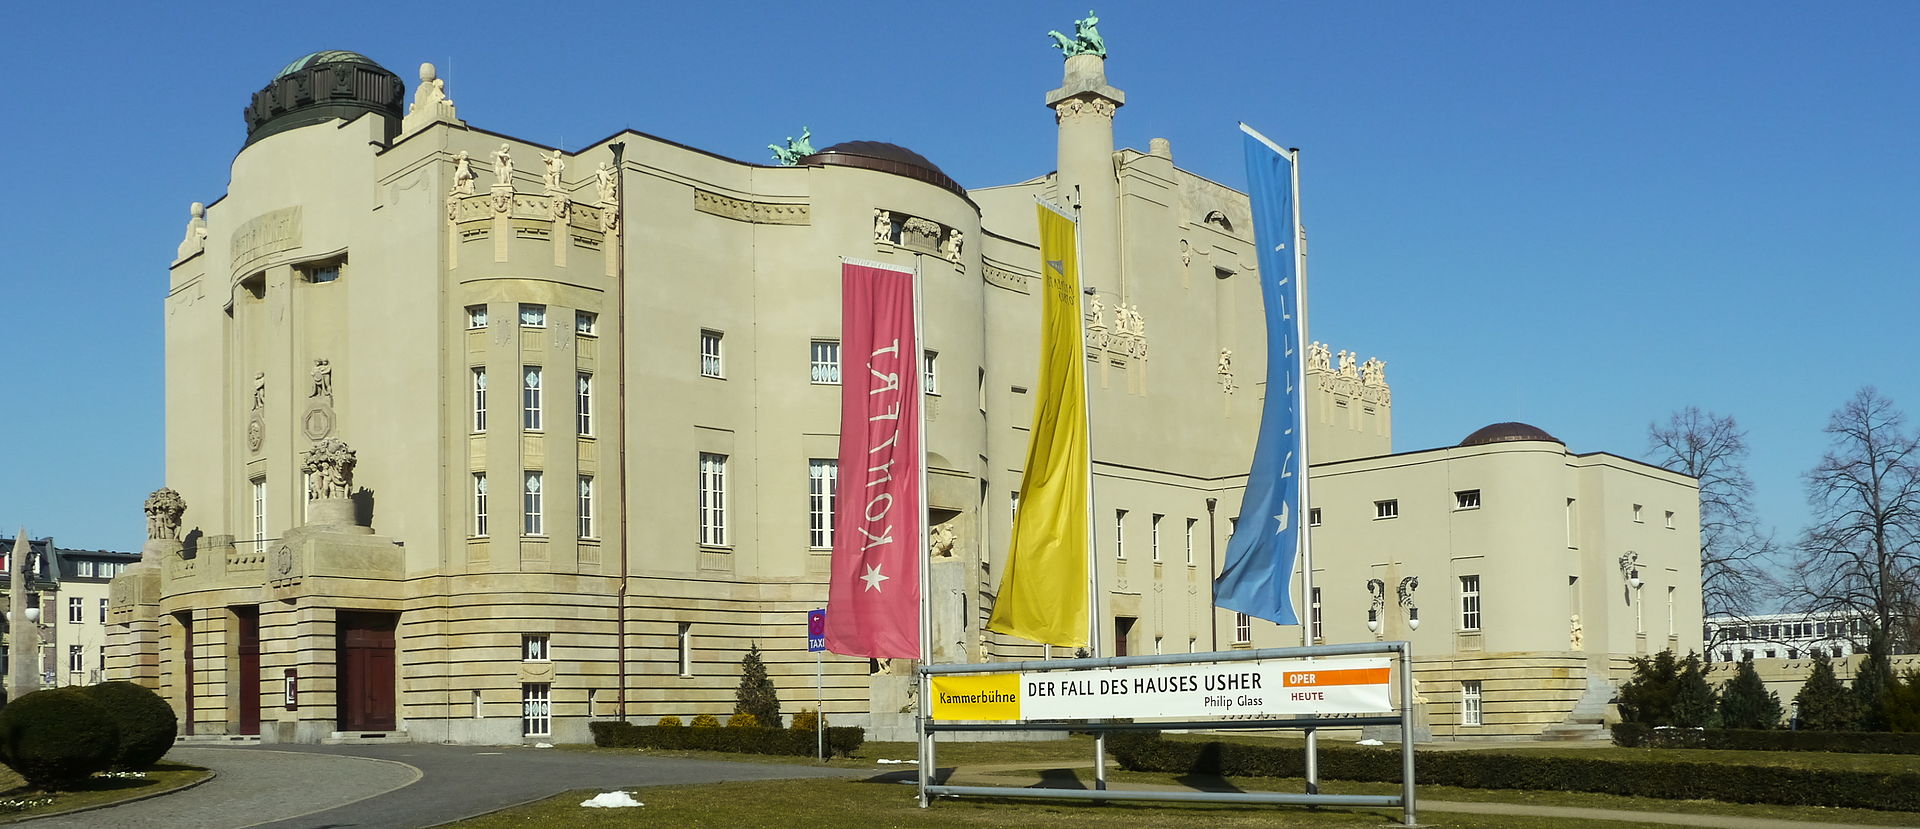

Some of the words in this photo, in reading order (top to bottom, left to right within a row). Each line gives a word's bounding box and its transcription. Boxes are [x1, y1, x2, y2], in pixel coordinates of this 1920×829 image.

[809, 638, 825, 649] TAXI
[1028, 681, 1055, 697] DER
[1061, 679, 1095, 697] FALL
[1100, 678, 1128, 695] DES
[1134, 675, 1198, 694] HAUSES
[1204, 672, 1262, 691] USHER
[1289, 673, 1316, 684] OPER
[939, 690, 1016, 704] Kammerbühne
[1204, 694, 1233, 710] Philip
[1237, 694, 1263, 707] Glass
[1291, 692, 1324, 701] HEUTE
